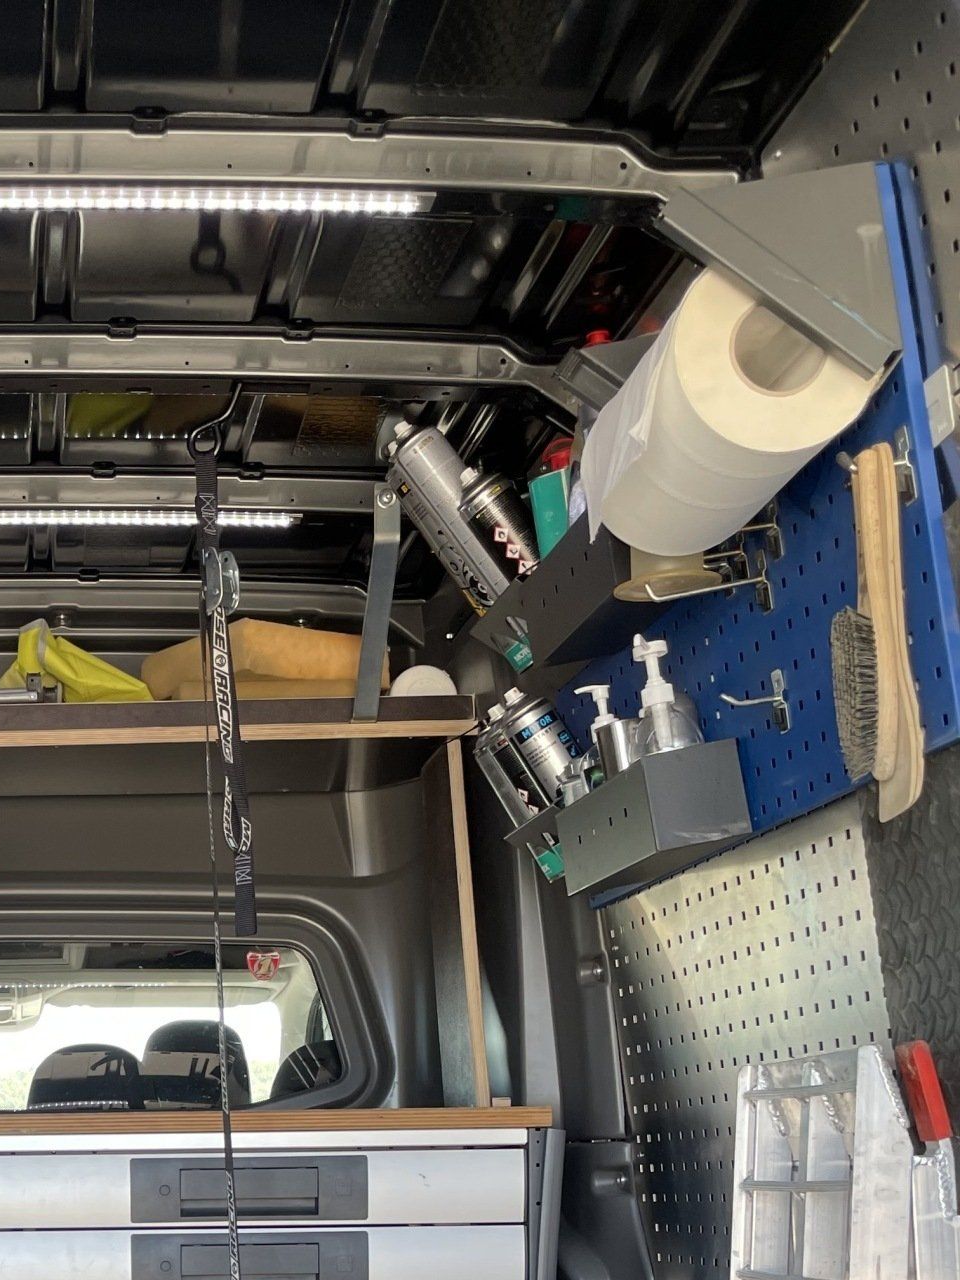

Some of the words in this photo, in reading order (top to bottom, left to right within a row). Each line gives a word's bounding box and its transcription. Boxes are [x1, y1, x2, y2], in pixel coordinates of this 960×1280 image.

[213, 606, 228, 653] OSE
[214, 669, 234, 764] RACING
[226, 1172, 239, 1262] RACING
